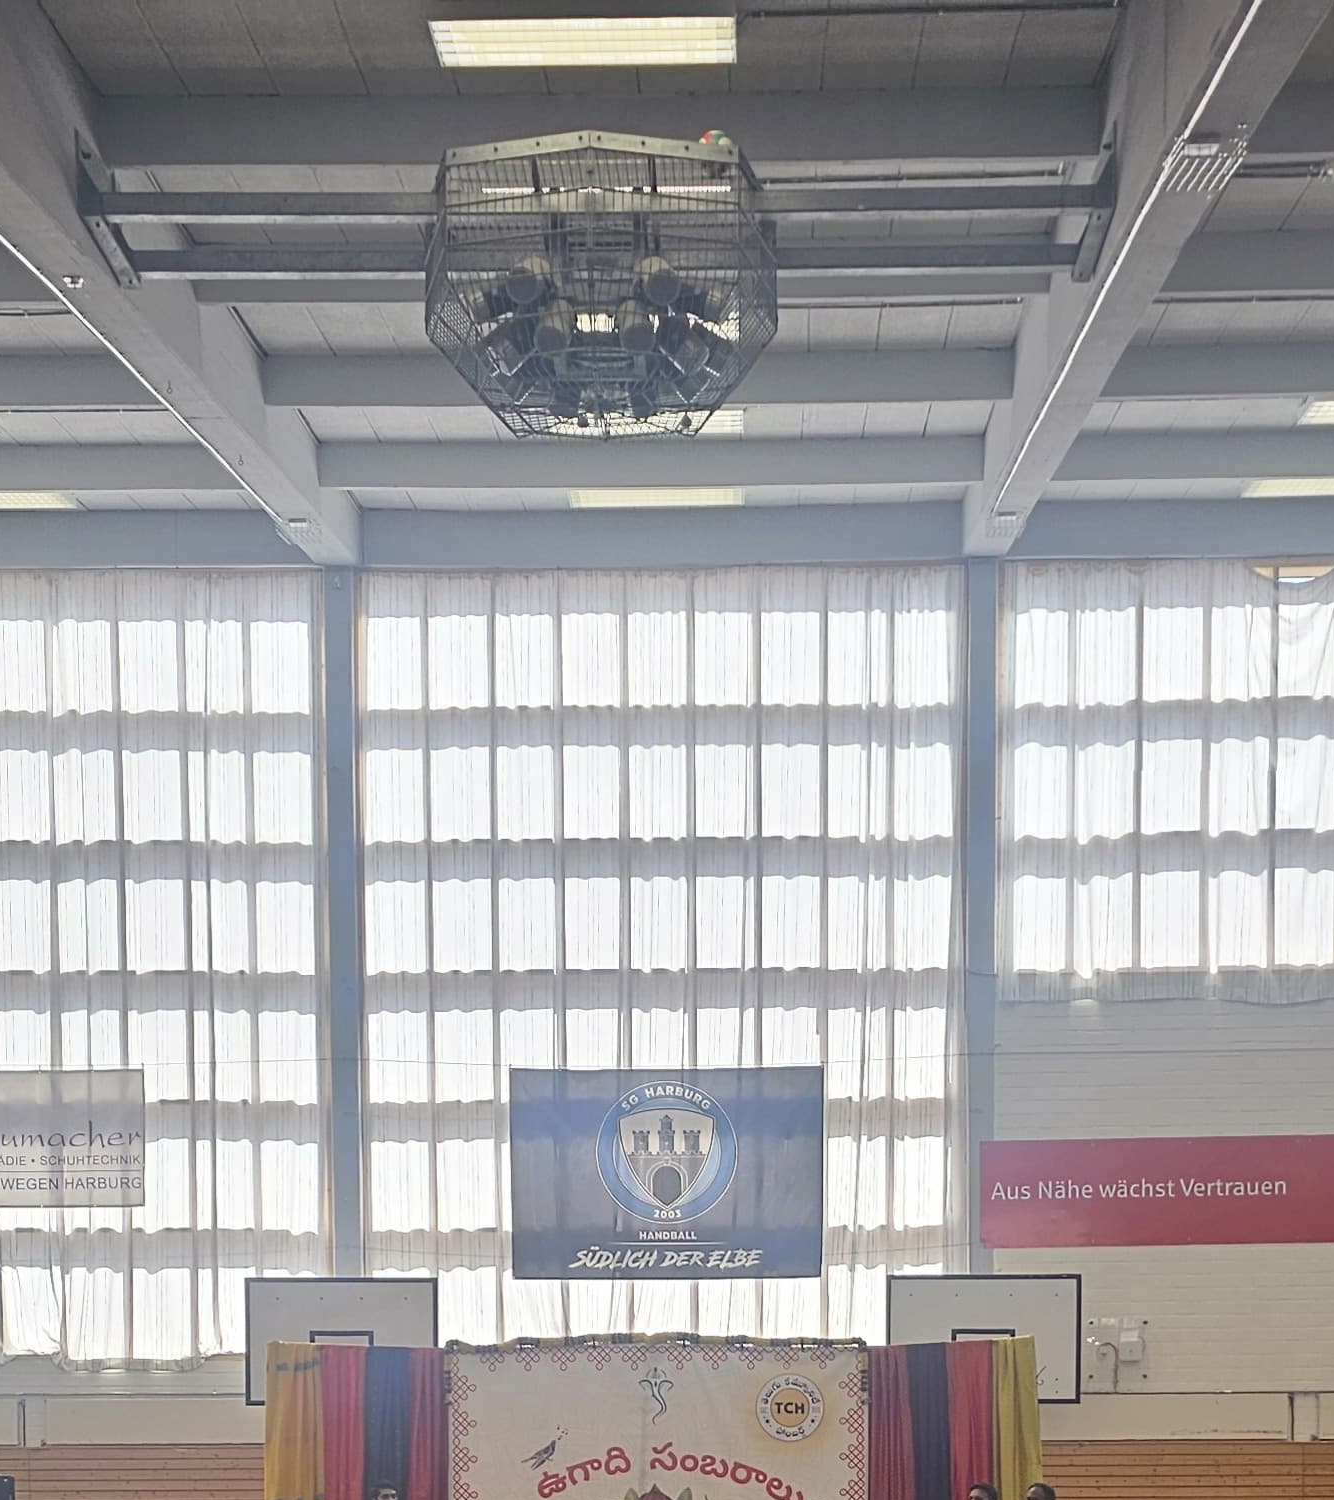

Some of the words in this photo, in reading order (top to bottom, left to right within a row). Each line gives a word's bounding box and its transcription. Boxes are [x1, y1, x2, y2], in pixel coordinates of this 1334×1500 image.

[621, 1094, 639, 1111] SG
[644, 1085, 712, 1110] HARBURG
[39, 1154, 142, 1166] SCHUHTECHNIK
[64, 1176, 143, 1190] HARBURG
[990, 1181, 1032, 1201] Aus
[1037, 1179, 1094, 1200] Nähe
[1098, 1177, 1175, 1199] wächst
[1179, 1177, 1288, 1197] Vertrauen
[639, 1231, 698, 1241] HANDBALL
[568, 1246, 658, 1270] SÜDLICH
[659, 1249, 705, 1268] DER
[704, 1248, 764, 1272] ELBE
[774, 1401, 805, 1415] TCH
[537, 1446, 632, 1499] ఉగాది
